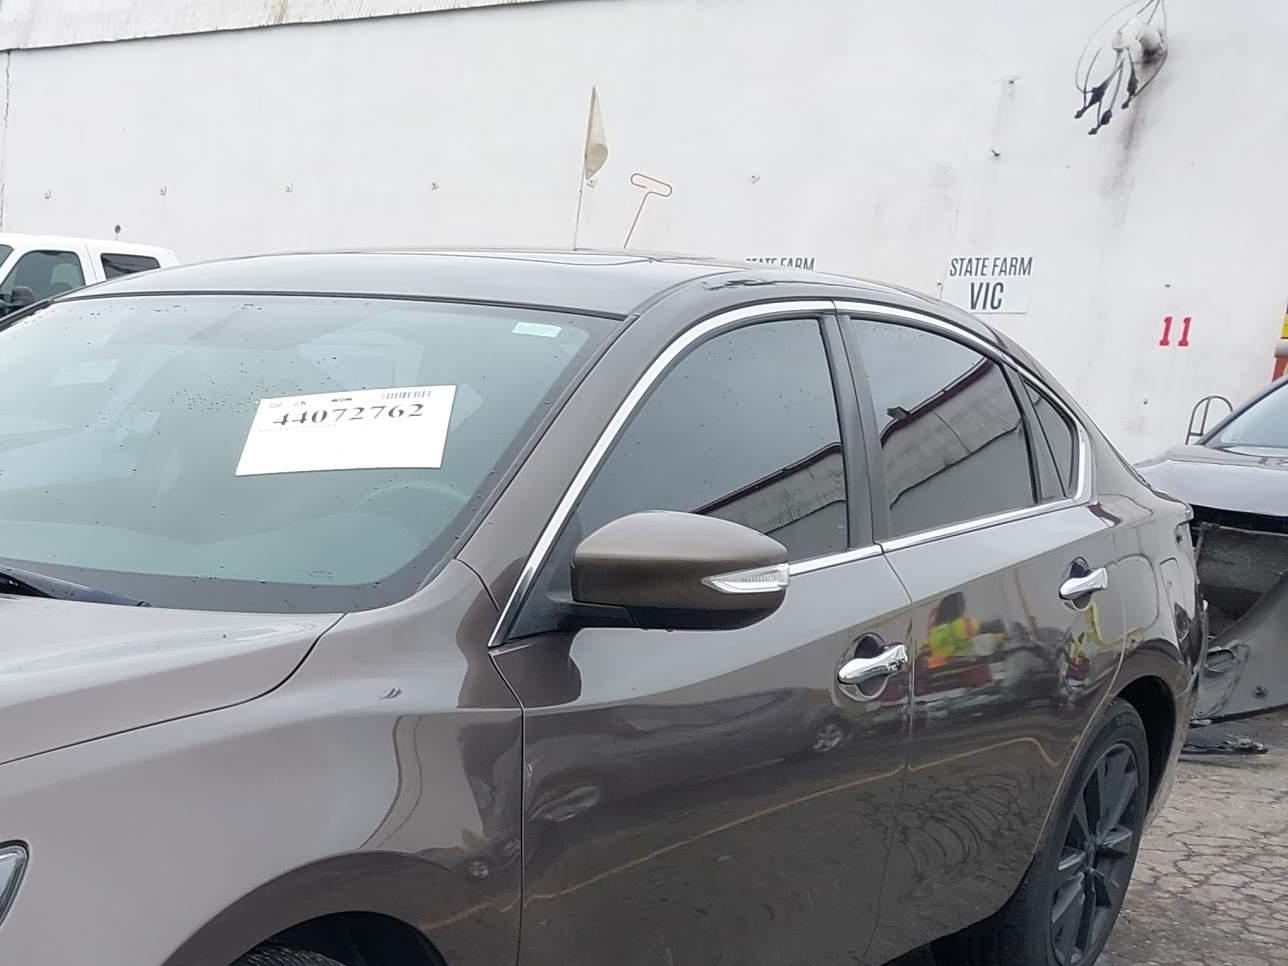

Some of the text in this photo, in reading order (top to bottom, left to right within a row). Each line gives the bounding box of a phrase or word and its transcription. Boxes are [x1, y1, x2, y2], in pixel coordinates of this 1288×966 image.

[949, 256, 1033, 277] STATE FARM
[970, 282, 1004, 310] VIC
[1159, 316, 1192, 347] 11
[272, 403, 424, 425] 44072762
